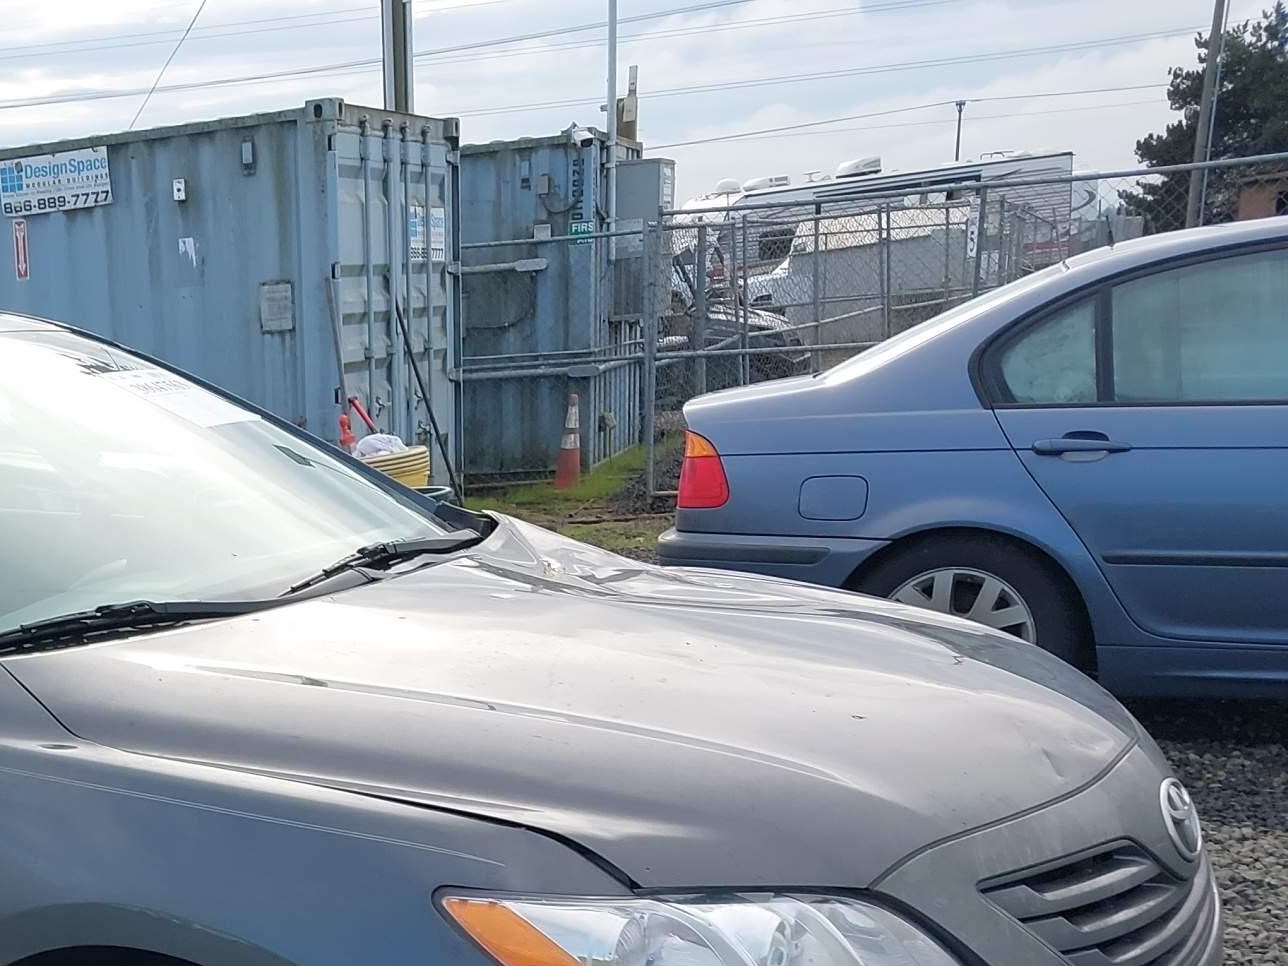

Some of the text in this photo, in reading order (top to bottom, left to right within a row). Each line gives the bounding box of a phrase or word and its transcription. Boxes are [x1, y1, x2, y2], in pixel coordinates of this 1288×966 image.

[24, 157, 107, 179] DesignSpace
[25, 173, 109, 188] MODULAR BUILDINGS
[572, 221, 594, 233] FIRS
